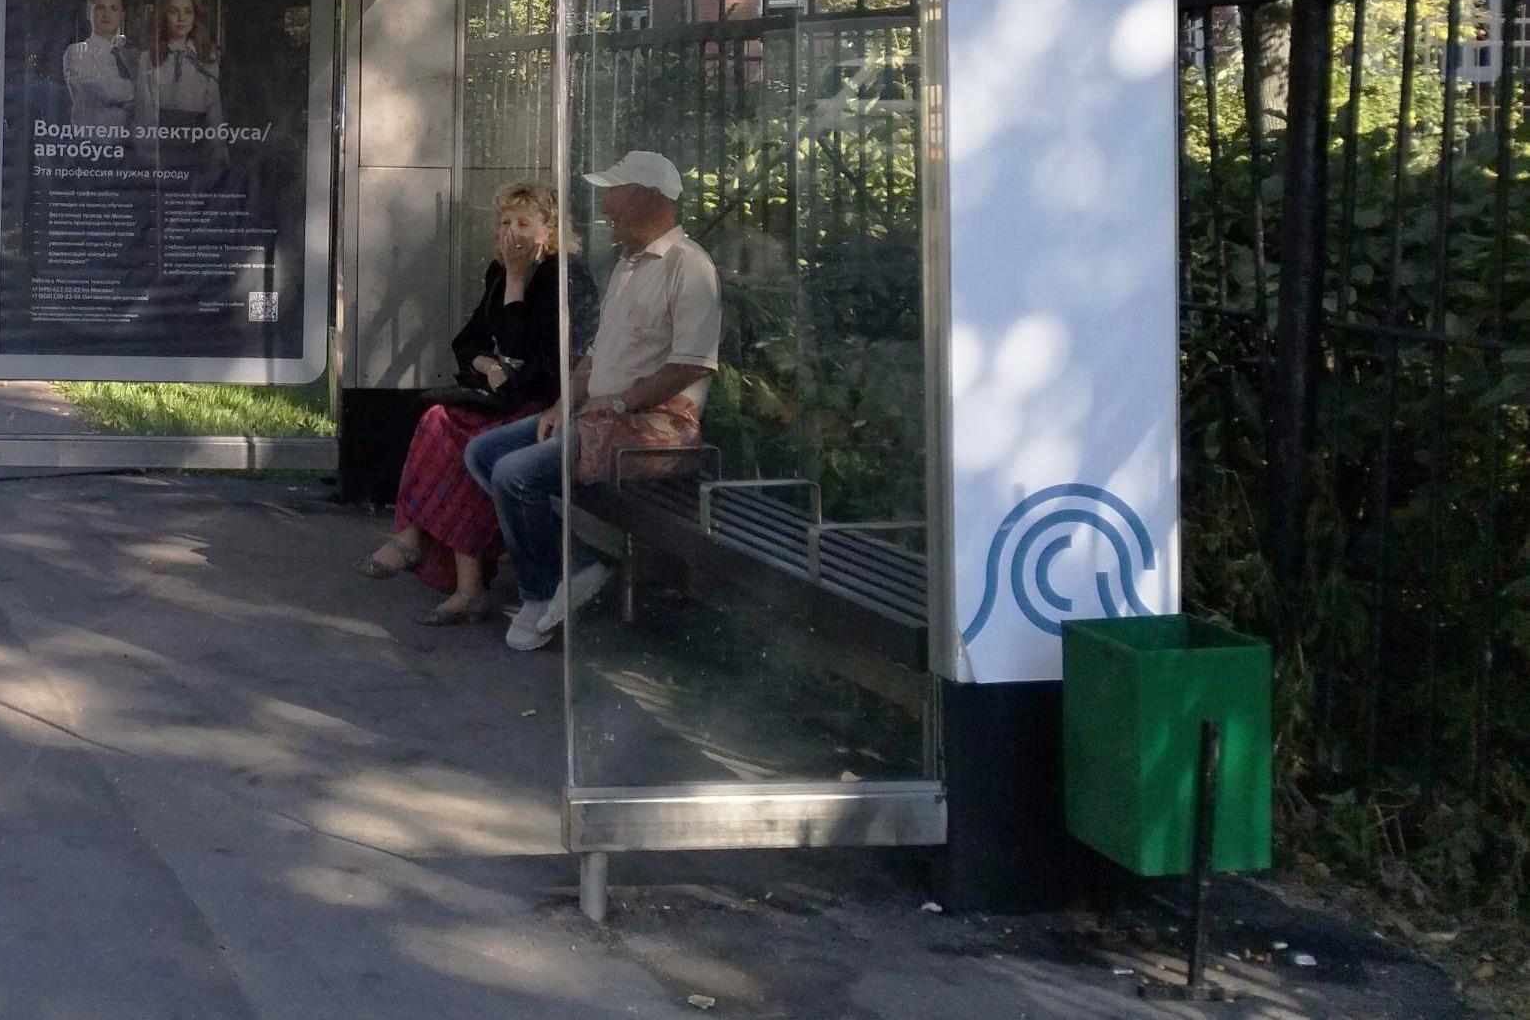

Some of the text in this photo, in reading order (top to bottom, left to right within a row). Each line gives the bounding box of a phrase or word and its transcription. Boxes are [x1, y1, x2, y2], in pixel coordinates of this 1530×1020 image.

[34, 119, 272, 144] Водитель электробуса/
[34, 140, 125, 161] автобуса
[33, 166, 52, 176] Эта
[55, 167, 114, 179] профессия
[152, 169, 190, 181] городу
